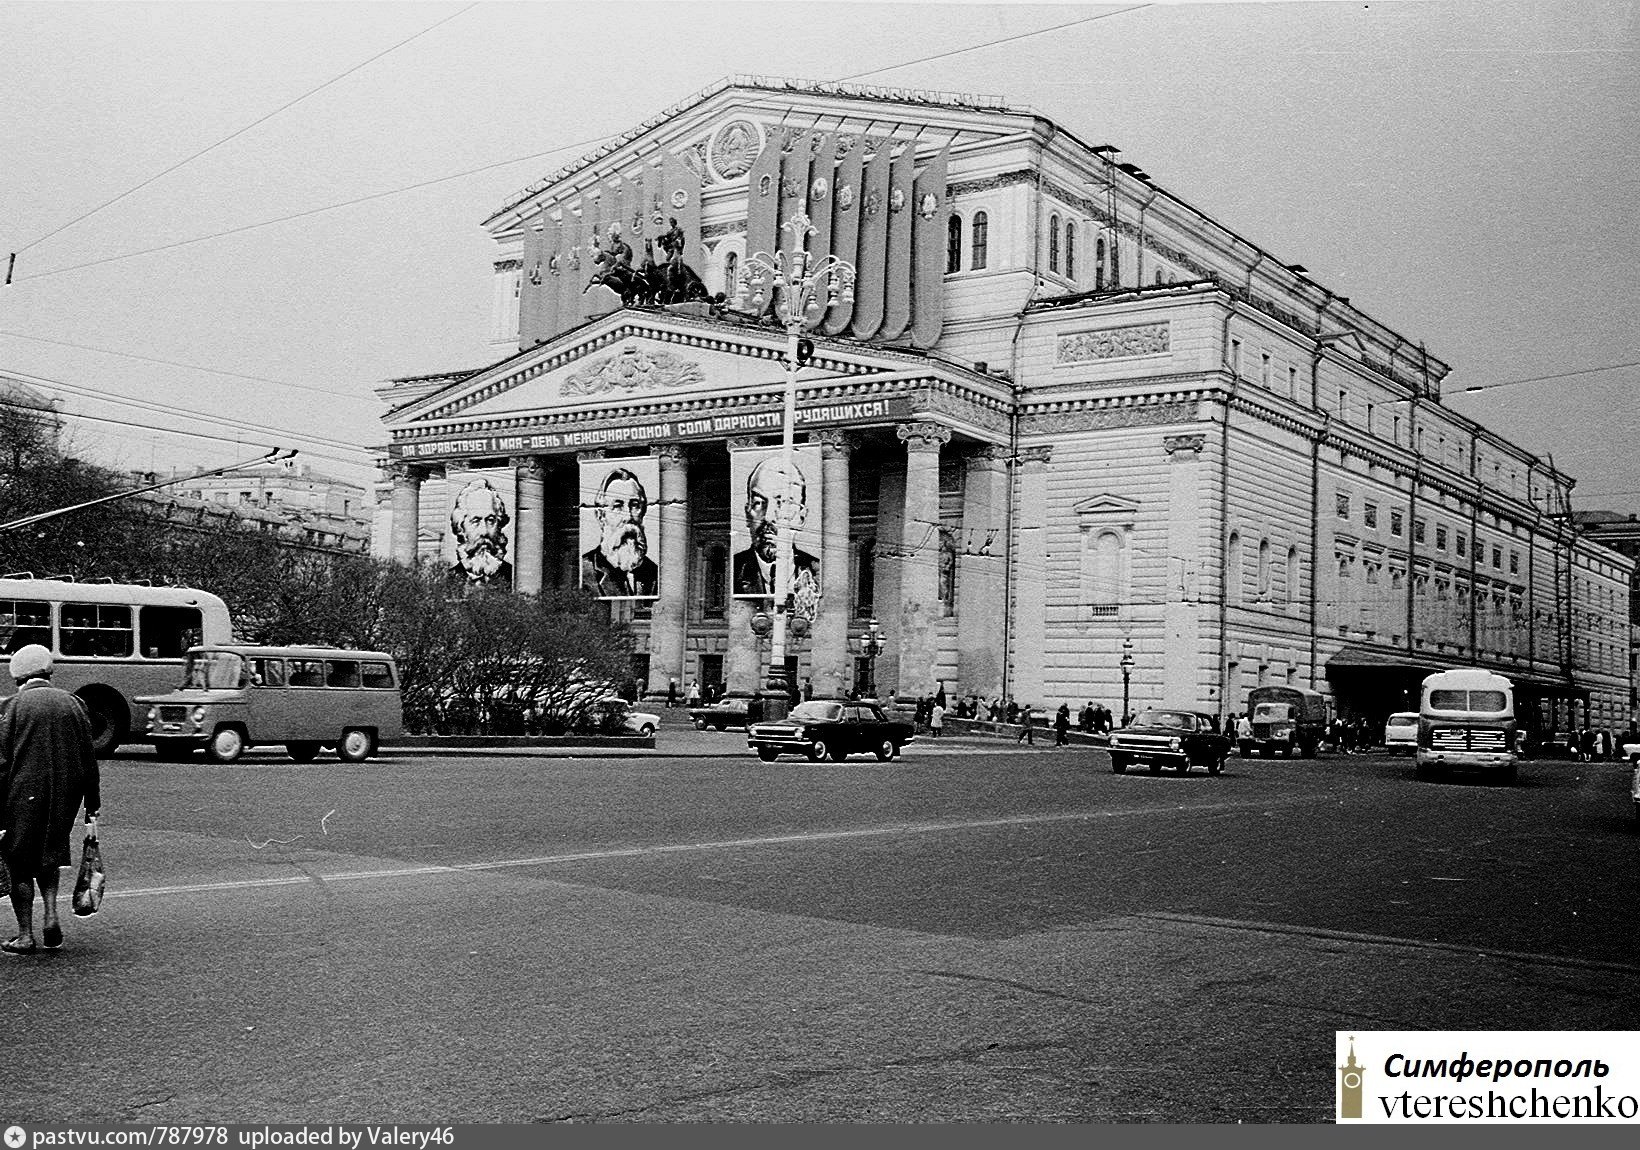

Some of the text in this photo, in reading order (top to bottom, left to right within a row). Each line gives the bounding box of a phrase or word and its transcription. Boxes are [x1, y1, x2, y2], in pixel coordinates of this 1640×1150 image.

[418, 440, 487, 456] ЗДРАВСТВУЕТ
[563, 423, 671, 446] МЕЖДУНАРОДНОЙ
[794, 400, 890, 424] РУДЯЩИХСЯ!
